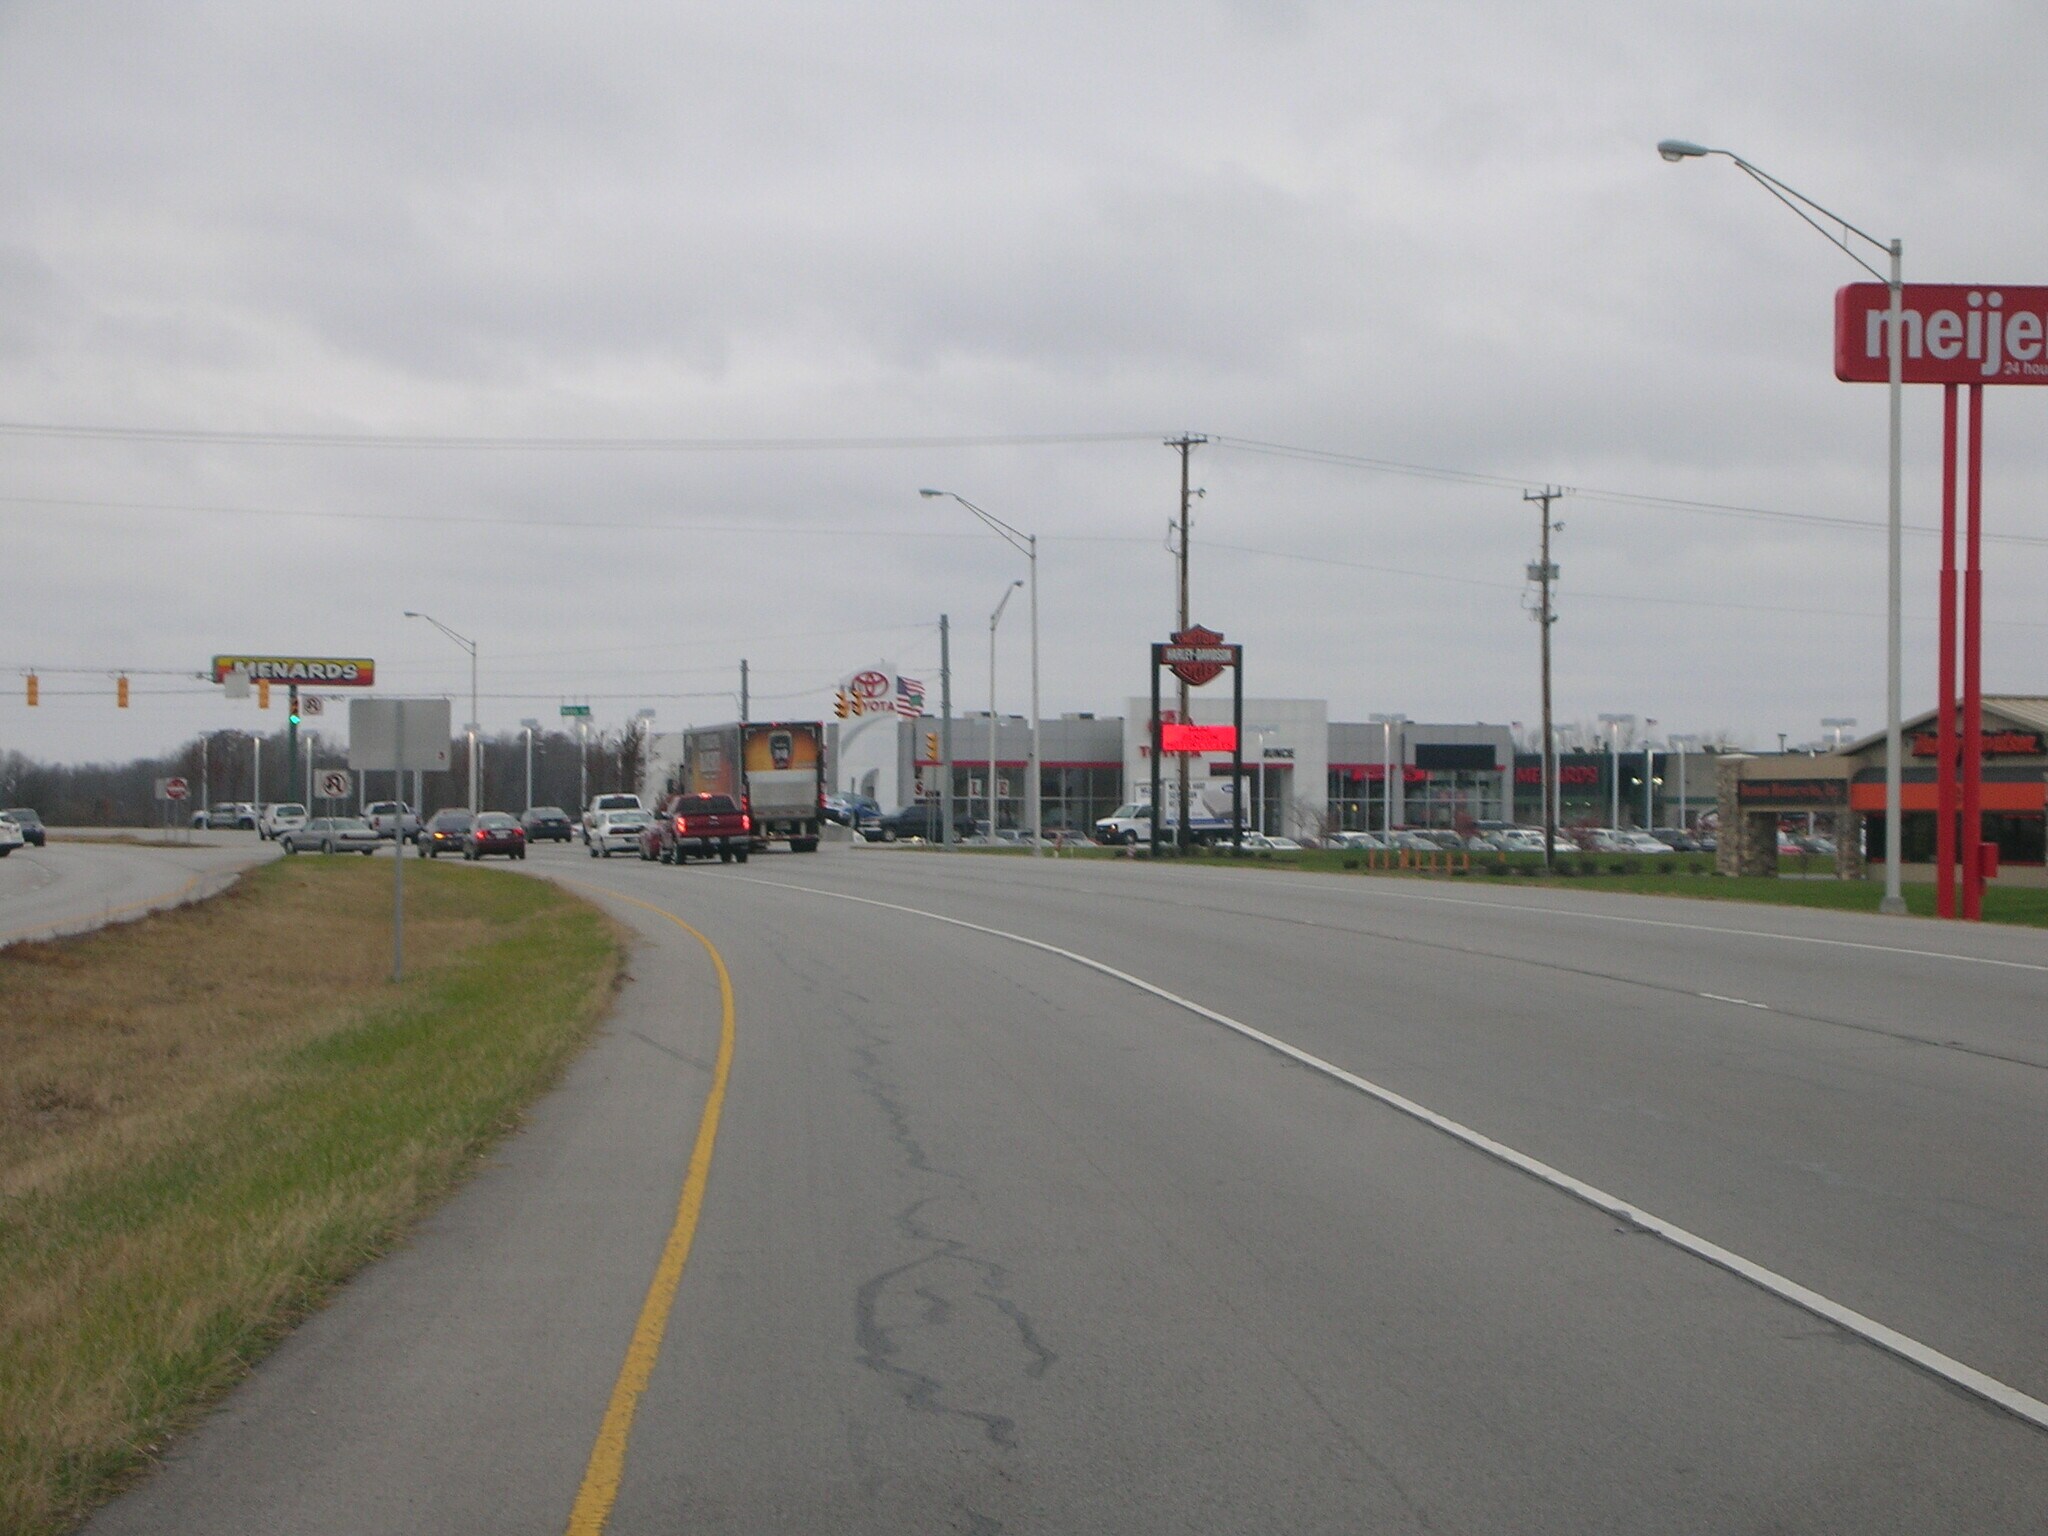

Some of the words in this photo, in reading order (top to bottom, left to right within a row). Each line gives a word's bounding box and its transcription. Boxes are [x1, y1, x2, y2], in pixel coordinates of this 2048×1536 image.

[1865, 291, 2048, 376] meije
[2003, 361, 2020, 375] 24
[234, 660, 359, 681] MENARDS
